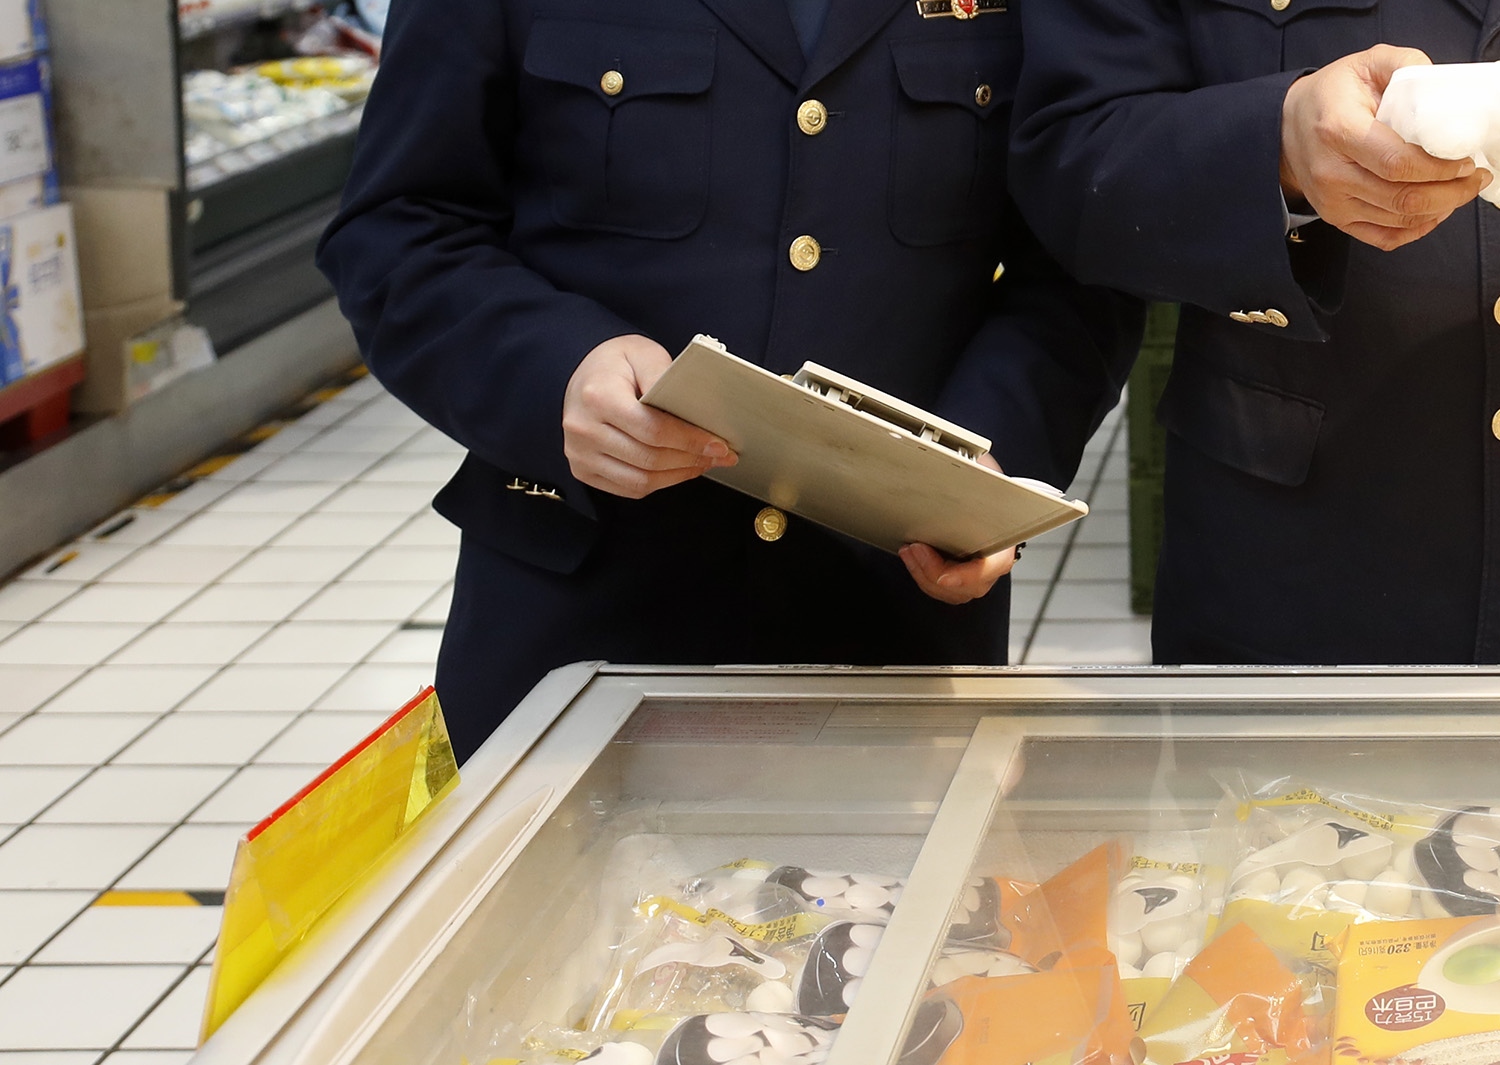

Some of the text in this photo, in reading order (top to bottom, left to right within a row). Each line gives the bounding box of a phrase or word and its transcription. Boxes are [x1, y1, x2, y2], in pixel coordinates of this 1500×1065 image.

[1371, 994, 1437, 1013] 巴旦木
[1375, 1010, 1433, 1025] 巧克力
